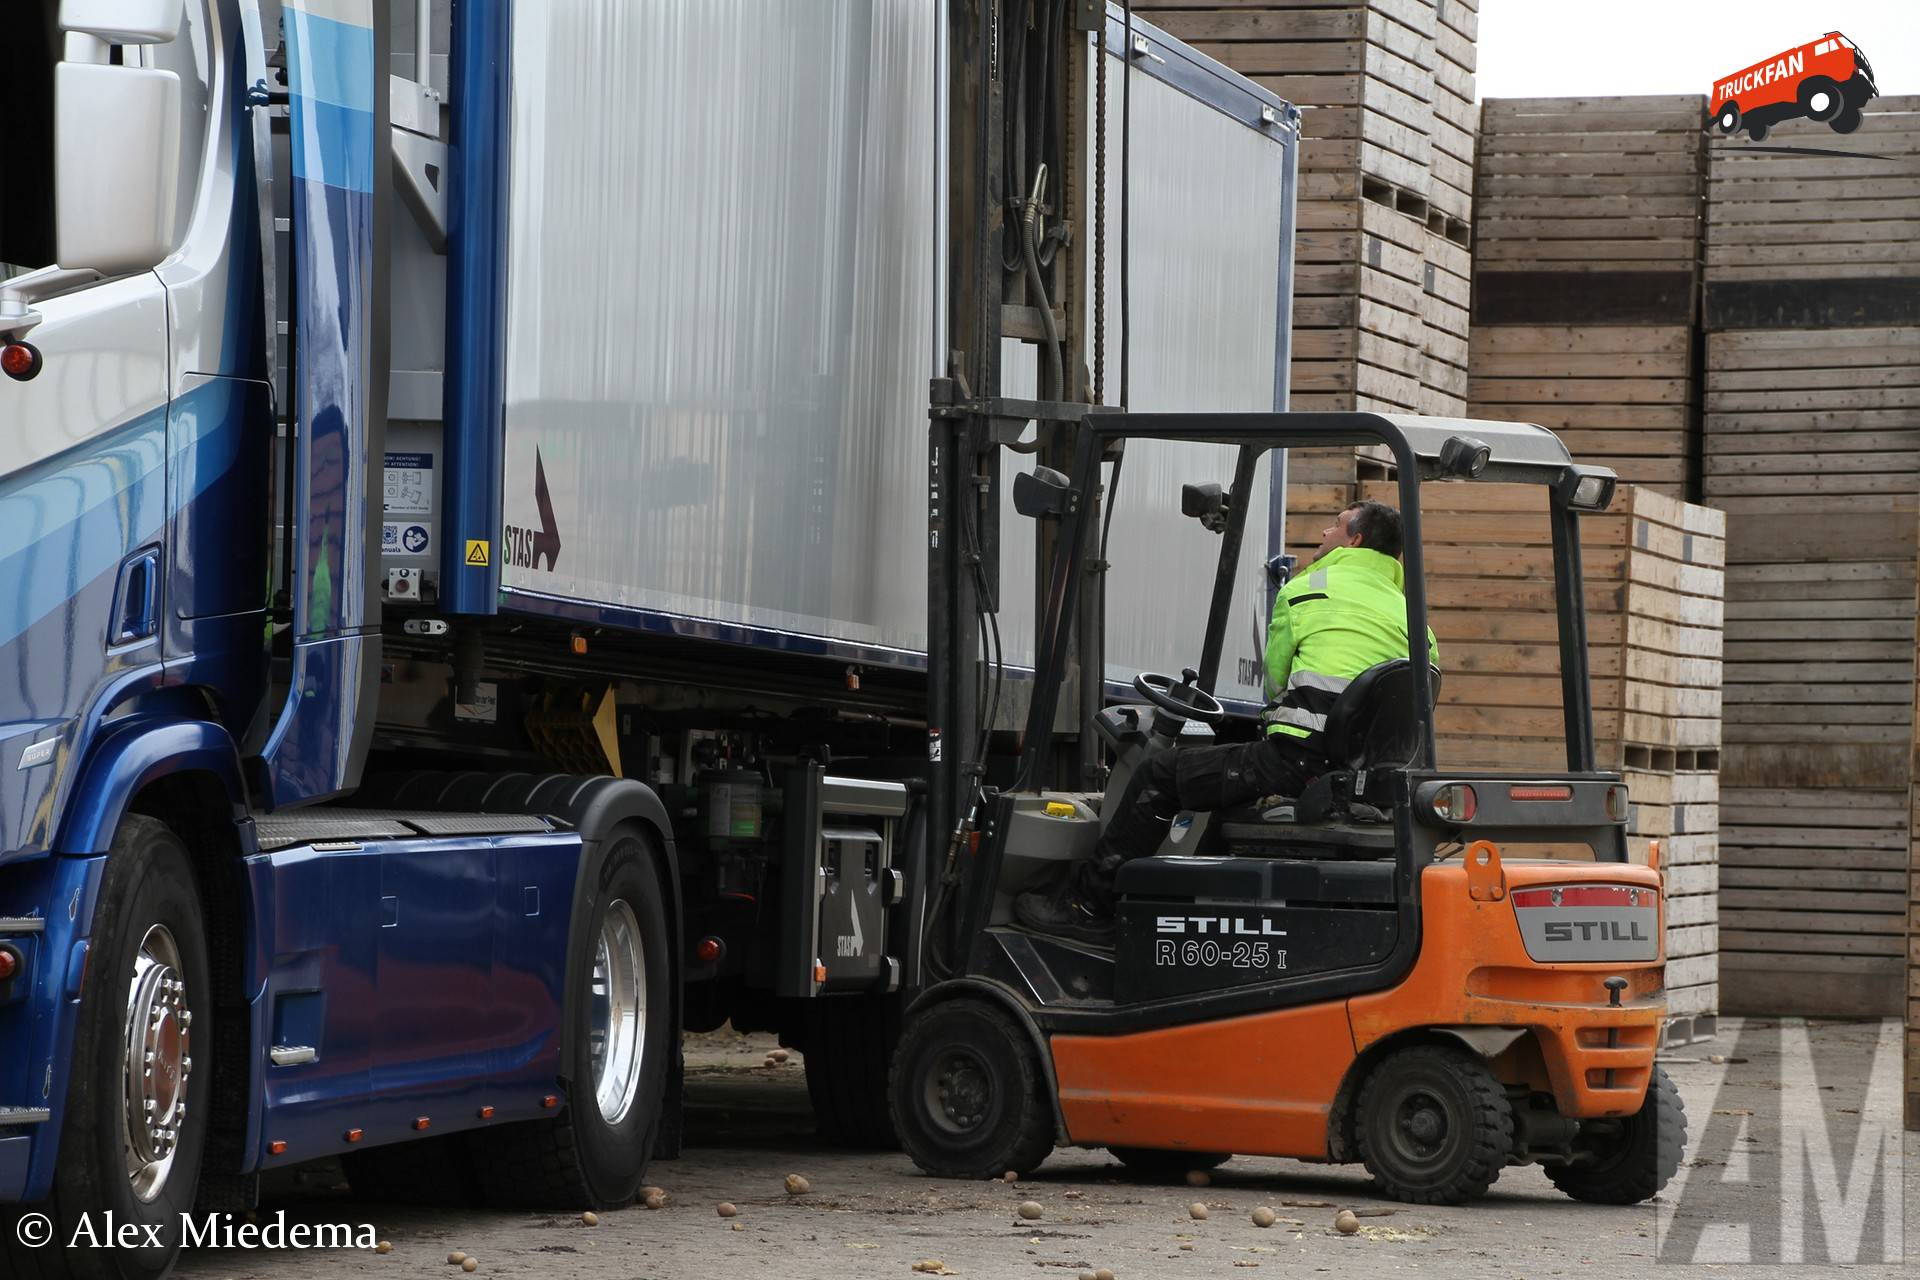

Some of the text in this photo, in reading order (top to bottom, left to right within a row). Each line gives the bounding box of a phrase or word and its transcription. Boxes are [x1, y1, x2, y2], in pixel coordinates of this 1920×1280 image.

[503, 524, 533, 569] STAS
[1237, 657, 1252, 686] STAS
[1156, 916, 1287, 936] STILL
[1544, 921, 1648, 942] STILL
[837, 935, 850, 957] STAS
[1156, 939, 1176, 966] R
[1181, 940, 1270, 968] 60-25
